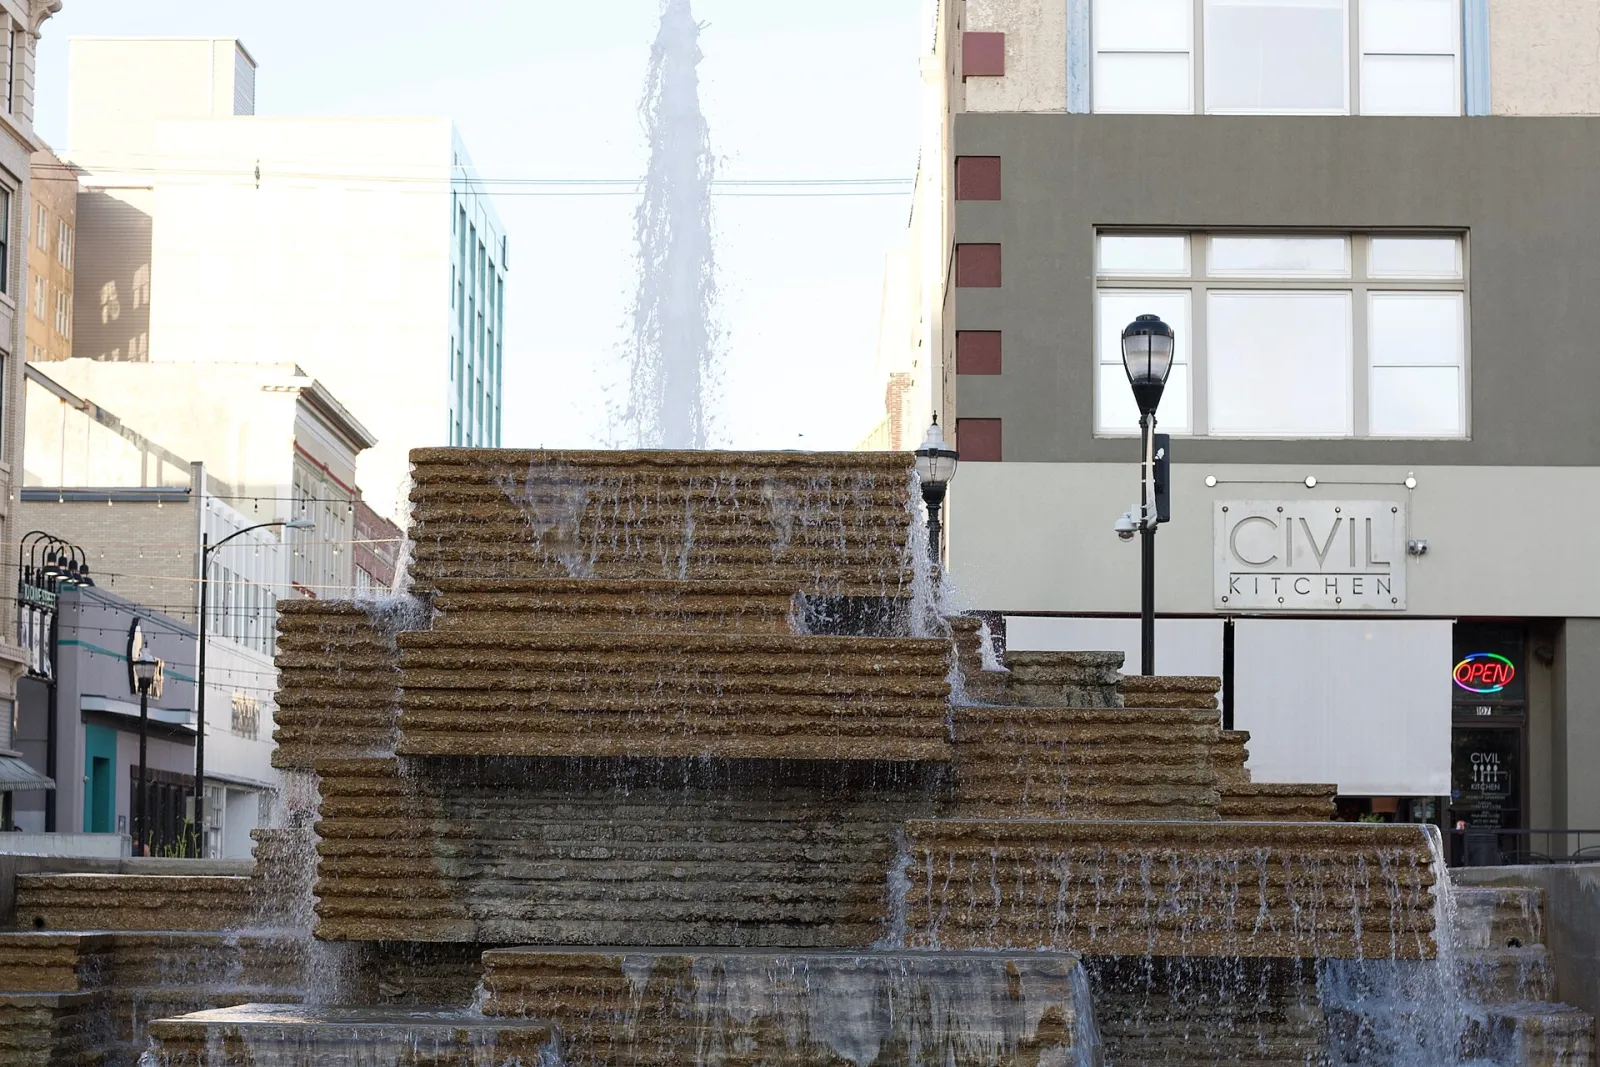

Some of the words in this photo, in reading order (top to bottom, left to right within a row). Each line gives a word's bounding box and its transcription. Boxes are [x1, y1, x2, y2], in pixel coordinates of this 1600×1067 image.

[1230, 515, 1390, 568] CIVIL
[1230, 577, 1391, 595] KITCHEN
[1457, 663, 1509, 682] OPEN
[1476, 706, 1492, 715] 107
[1470, 752, 1500, 763] CIVIL
